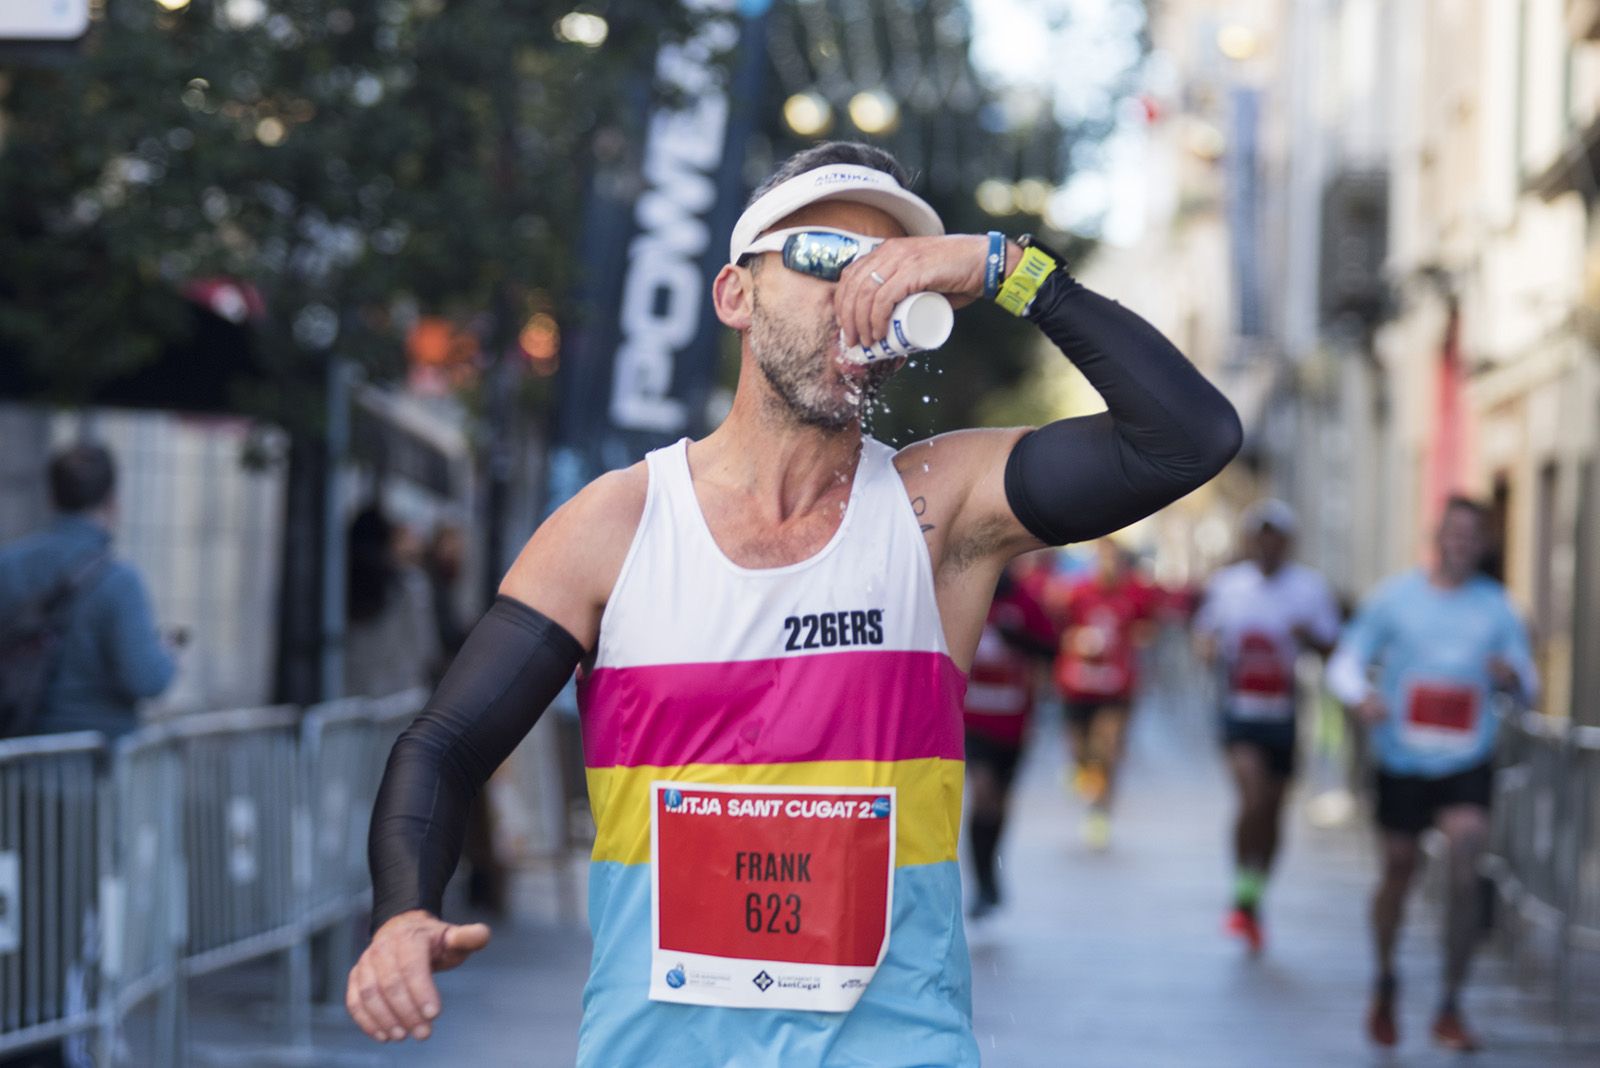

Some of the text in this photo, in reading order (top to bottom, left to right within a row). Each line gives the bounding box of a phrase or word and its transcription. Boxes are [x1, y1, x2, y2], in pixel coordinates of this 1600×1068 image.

[608, 0, 741, 431] POWE
[784, 609, 883, 651] 226ERS
[727, 799, 783, 817] SANT
[785, 800, 857, 818] CUGAT
[736, 852, 811, 882] FRANK
[745, 893, 802, 934] 623
